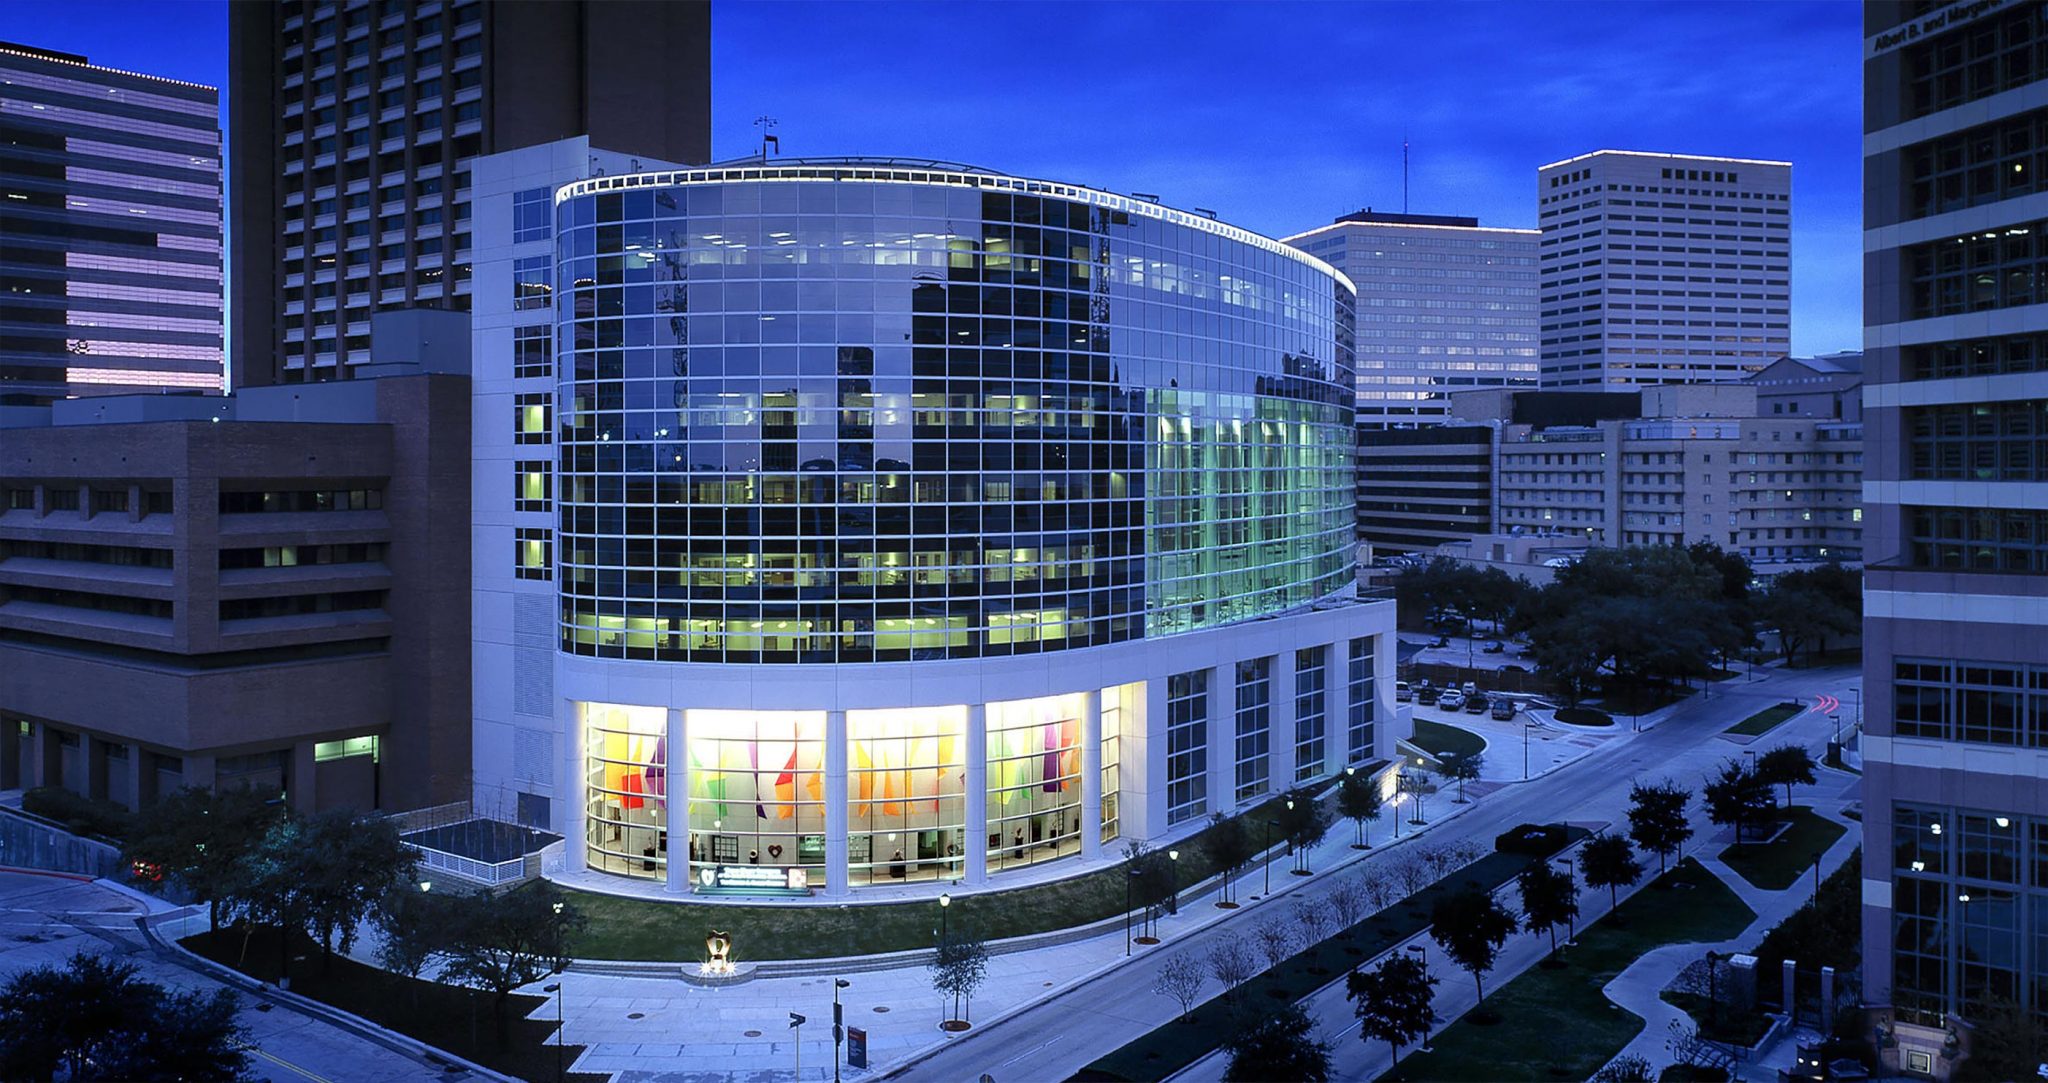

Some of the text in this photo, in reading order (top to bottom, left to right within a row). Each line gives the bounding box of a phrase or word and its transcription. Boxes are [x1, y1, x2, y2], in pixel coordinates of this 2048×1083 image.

[1873, 28, 1907, 52] Albert
[1909, 24, 1921, 39] B.
[1923, 12, 1946, 33] and
